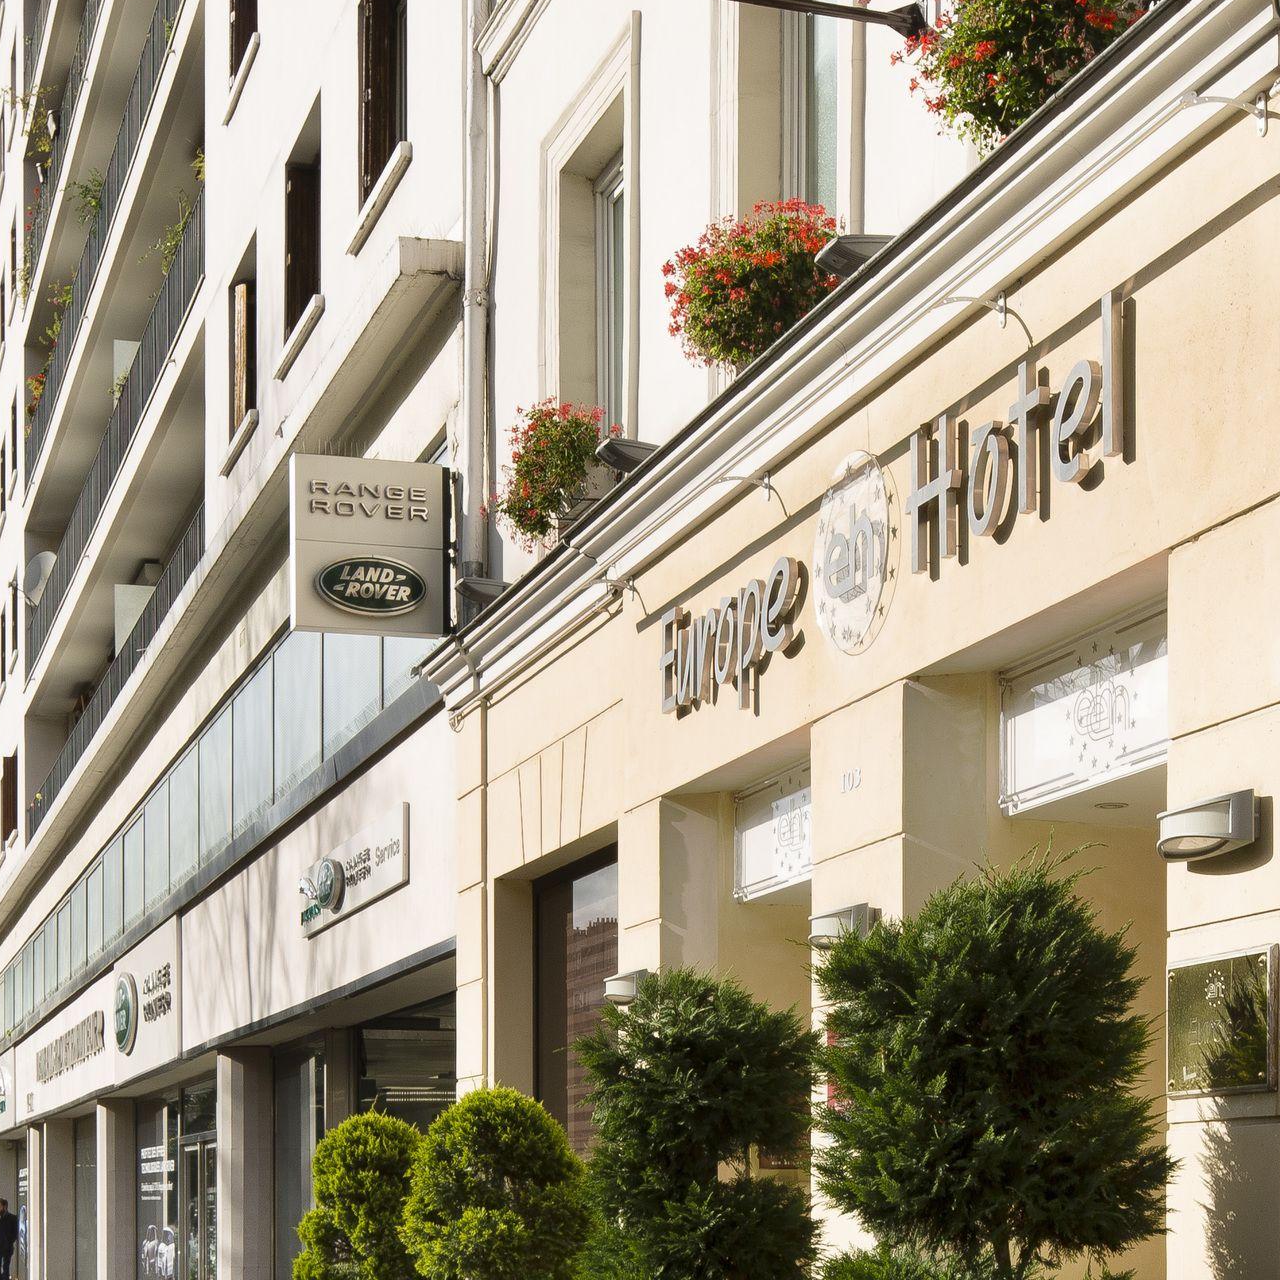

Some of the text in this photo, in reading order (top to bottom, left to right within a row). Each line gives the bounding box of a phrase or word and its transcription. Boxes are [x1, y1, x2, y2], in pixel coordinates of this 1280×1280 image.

[310, 479, 427, 502] RANGE
[310, 499, 428, 521] ROVER
[659, 556, 797, 715] Europe
[840, 768, 862, 794] 103
[375, 838, 400, 867] Service
